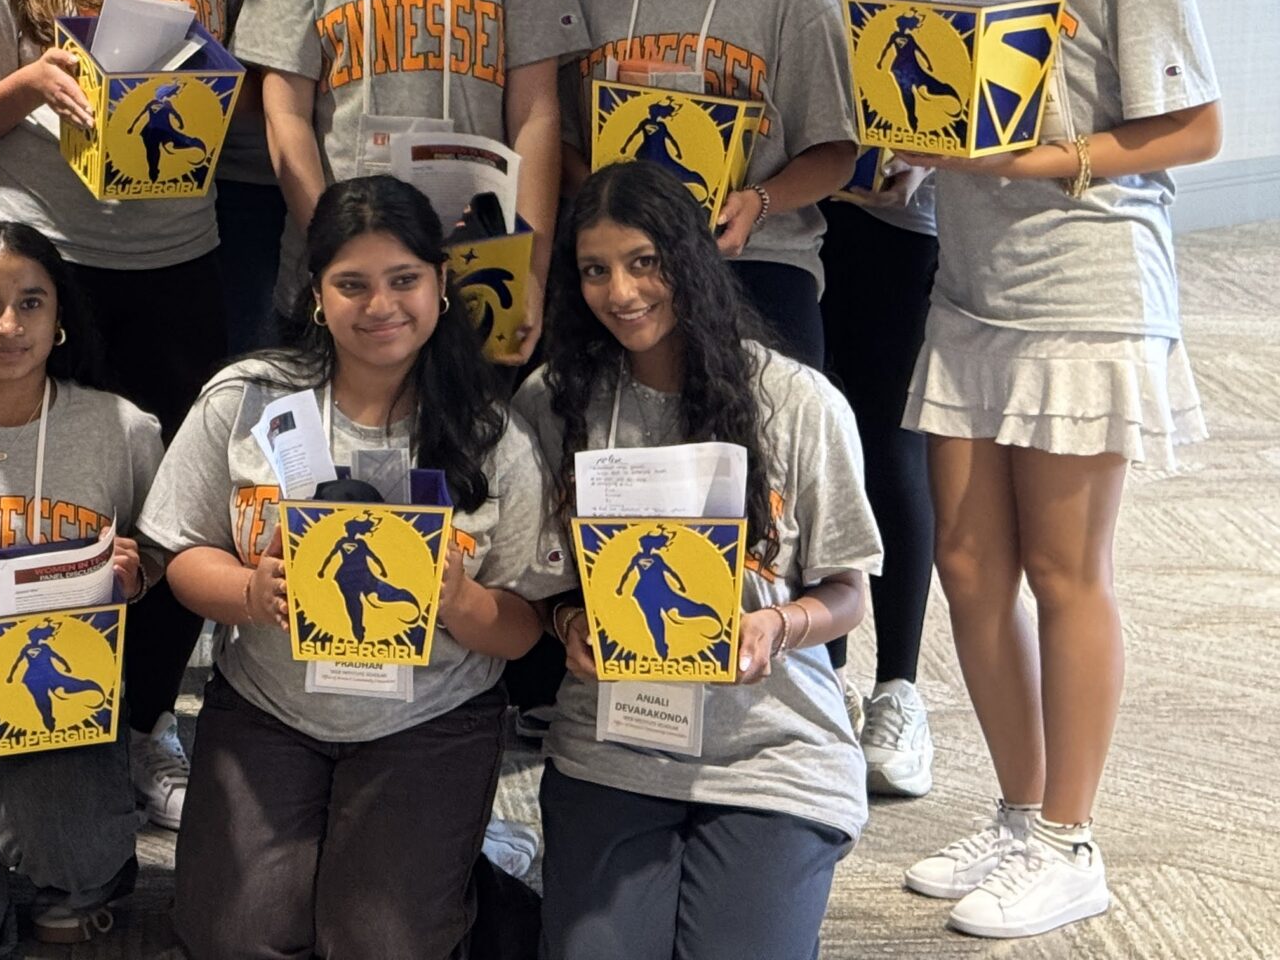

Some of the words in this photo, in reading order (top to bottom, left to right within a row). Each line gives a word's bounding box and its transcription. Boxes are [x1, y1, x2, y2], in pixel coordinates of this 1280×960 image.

[866, 127, 967, 152] SUPERGIRL
[105, 181, 203, 196] SUPERGIRL
[34, 562, 75, 576] WOMEN
[77, 559, 88, 570] IN
[40, 571, 63, 581] PANEL
[300, 641, 423, 660] SUPERGIRL
[335, 660, 384, 670] PRADHAN
[604, 659, 730, 675] SUPERGIRL
[636, 693, 670, 707] ANJALI
[615, 702, 689, 725] DEVARAKONDA
